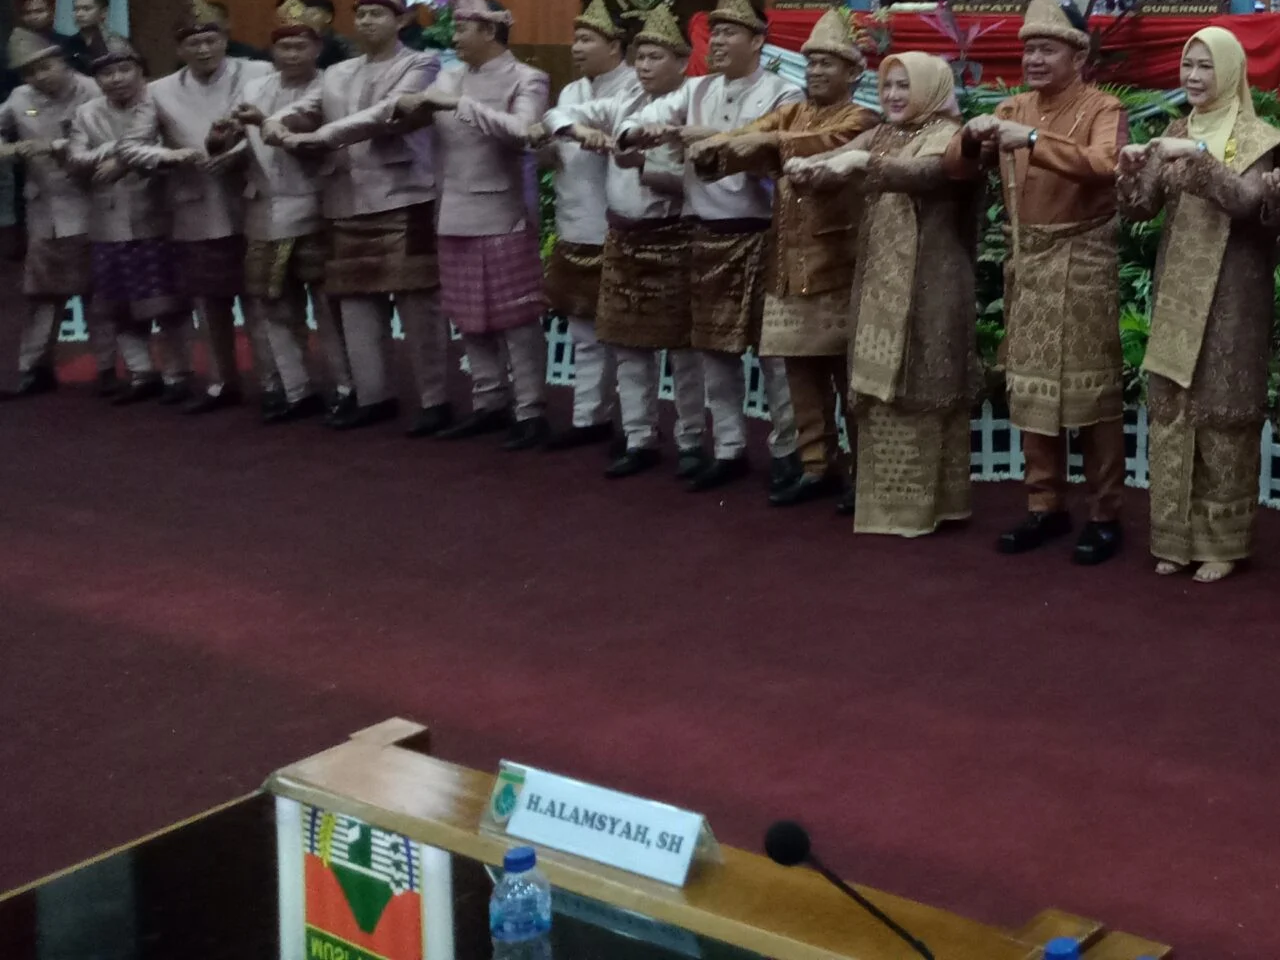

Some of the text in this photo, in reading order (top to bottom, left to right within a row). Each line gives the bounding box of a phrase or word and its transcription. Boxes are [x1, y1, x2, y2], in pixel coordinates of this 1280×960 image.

[952, 3, 1021, 13] BUPATI
[1142, 5, 1218, 14] GUBERNUR
[526, 793, 685, 855] H.ALAMSYAH, SH
